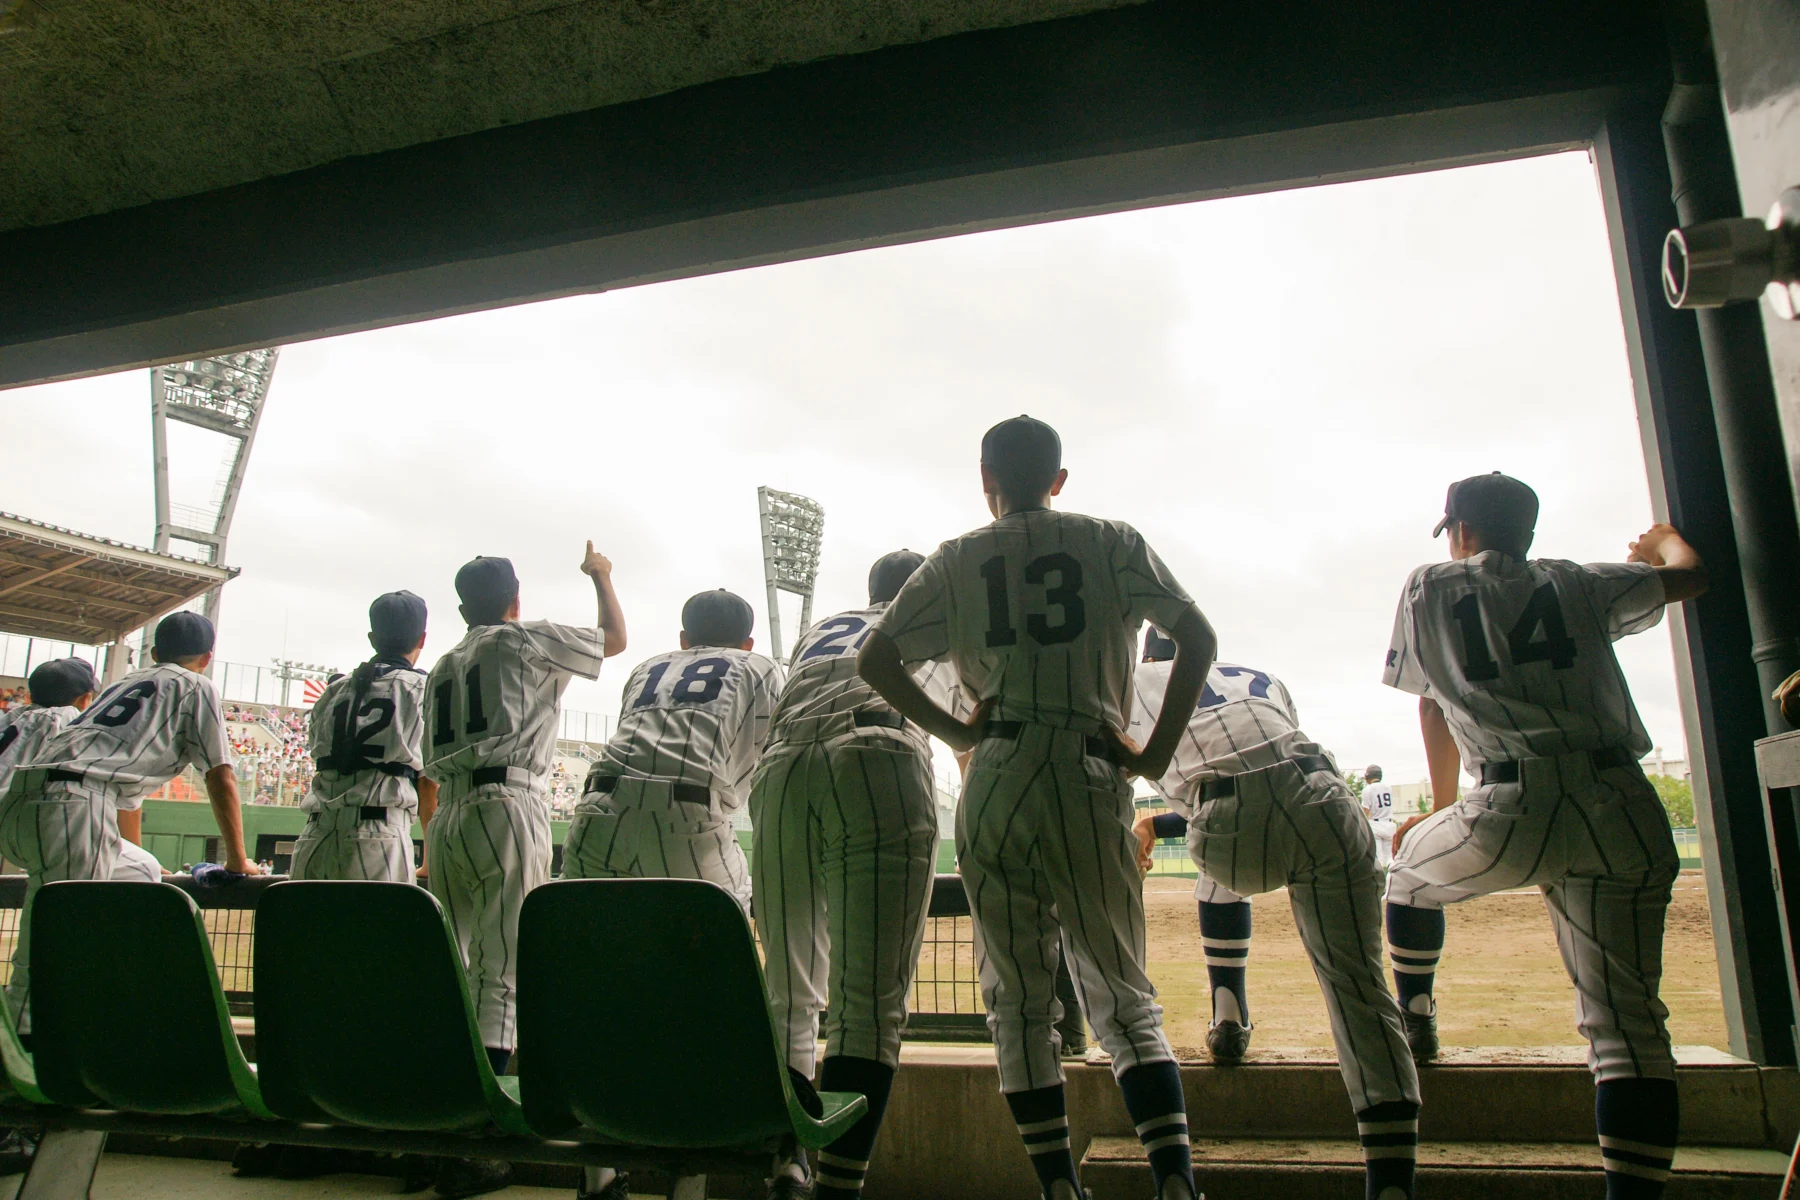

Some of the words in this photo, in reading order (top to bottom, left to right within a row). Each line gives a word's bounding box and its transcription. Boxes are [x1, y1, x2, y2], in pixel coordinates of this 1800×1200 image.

[981, 552, 1085, 647] 13
[800, 617, 876, 660] 2
[1453, 582, 1577, 681] 14
[432, 664, 488, 747] 11
[632, 657, 731, 708] 18
[330, 698, 396, 759] 12
[1376, 792, 1392, 808] 19
